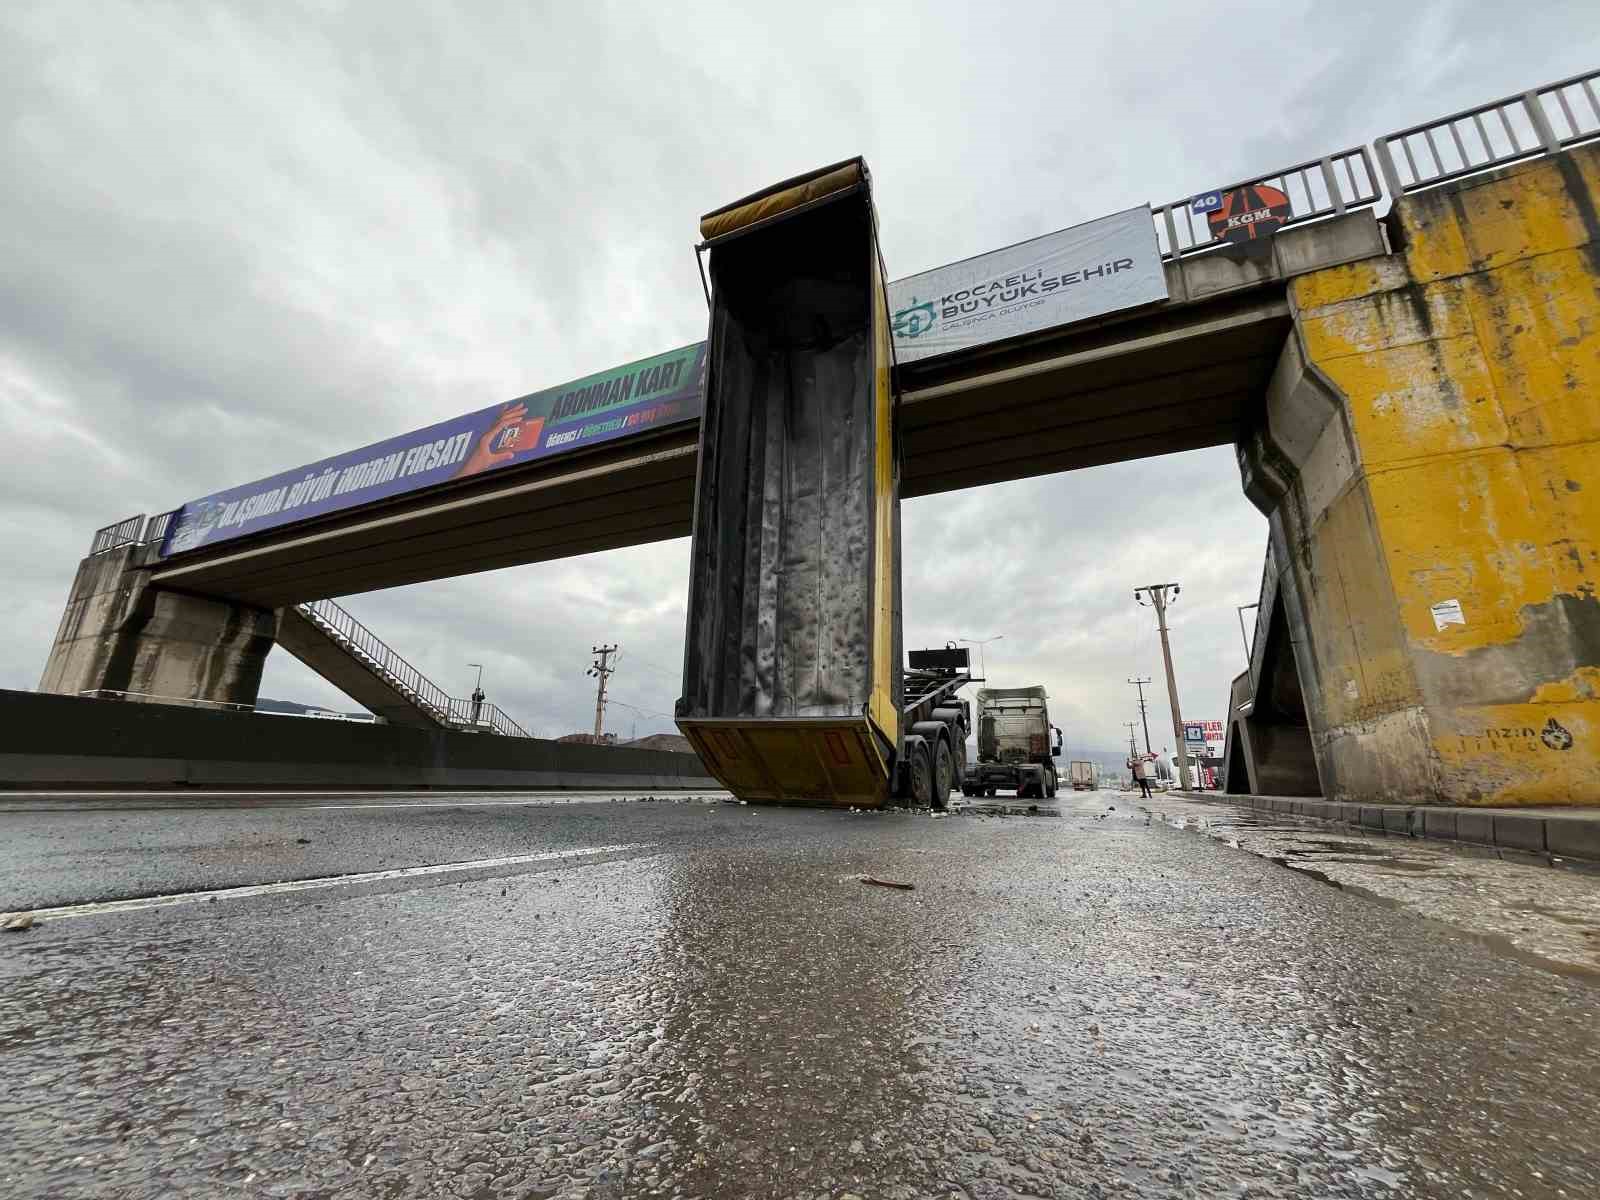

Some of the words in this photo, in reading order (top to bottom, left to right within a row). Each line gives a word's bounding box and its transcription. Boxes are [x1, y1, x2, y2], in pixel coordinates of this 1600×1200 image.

[1194, 196, 1218, 209] 40
[1228, 208, 1272, 229] KGM
[634, 357, 688, 398] KART
[398, 431, 473, 478] FIRSATI
